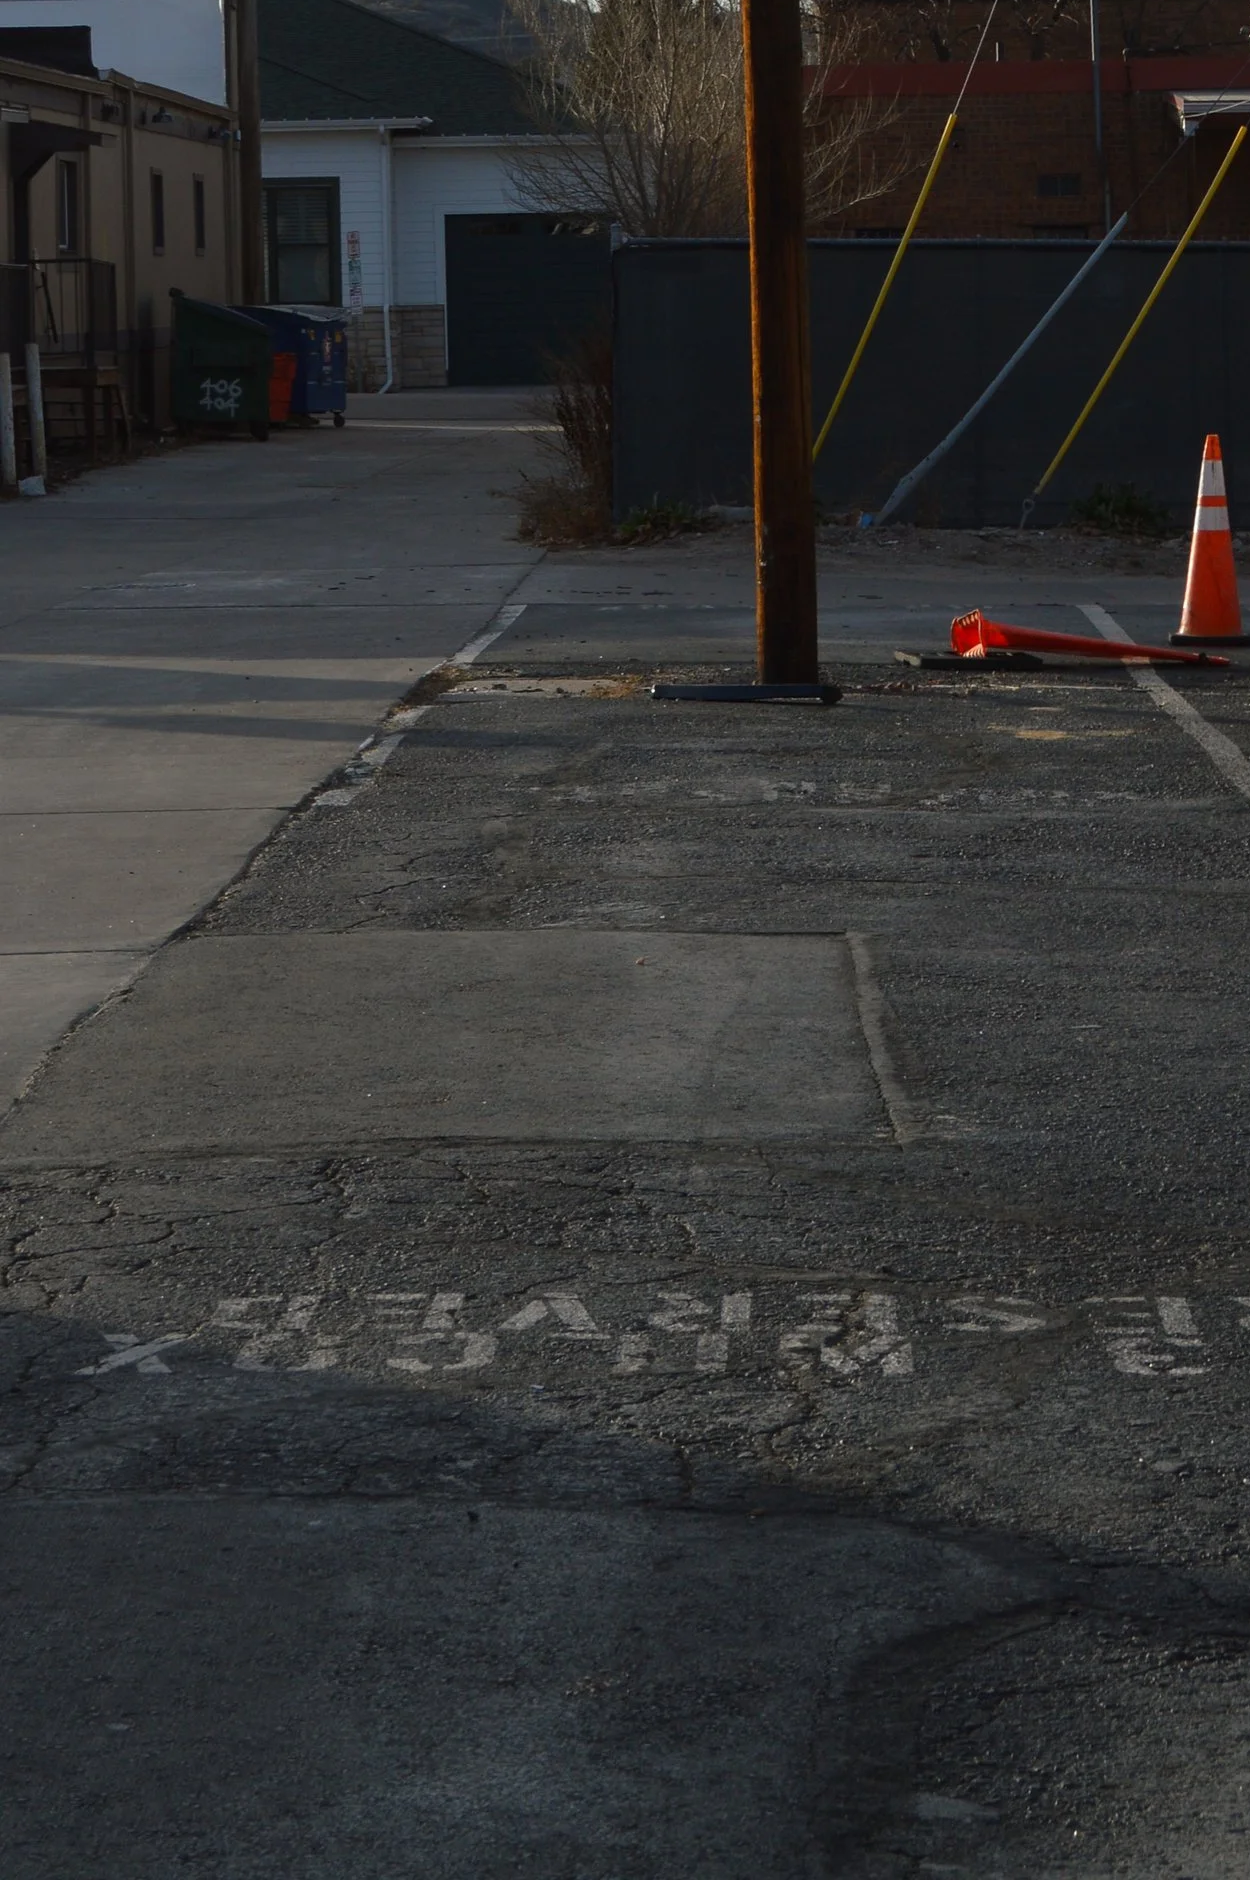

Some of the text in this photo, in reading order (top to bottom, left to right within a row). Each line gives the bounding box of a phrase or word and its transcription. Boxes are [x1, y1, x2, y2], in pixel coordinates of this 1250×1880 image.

[200, 377, 243, 398] 406
[198, 395, 241, 418] 404
[74, 1331, 913, 1377] WILCOX
